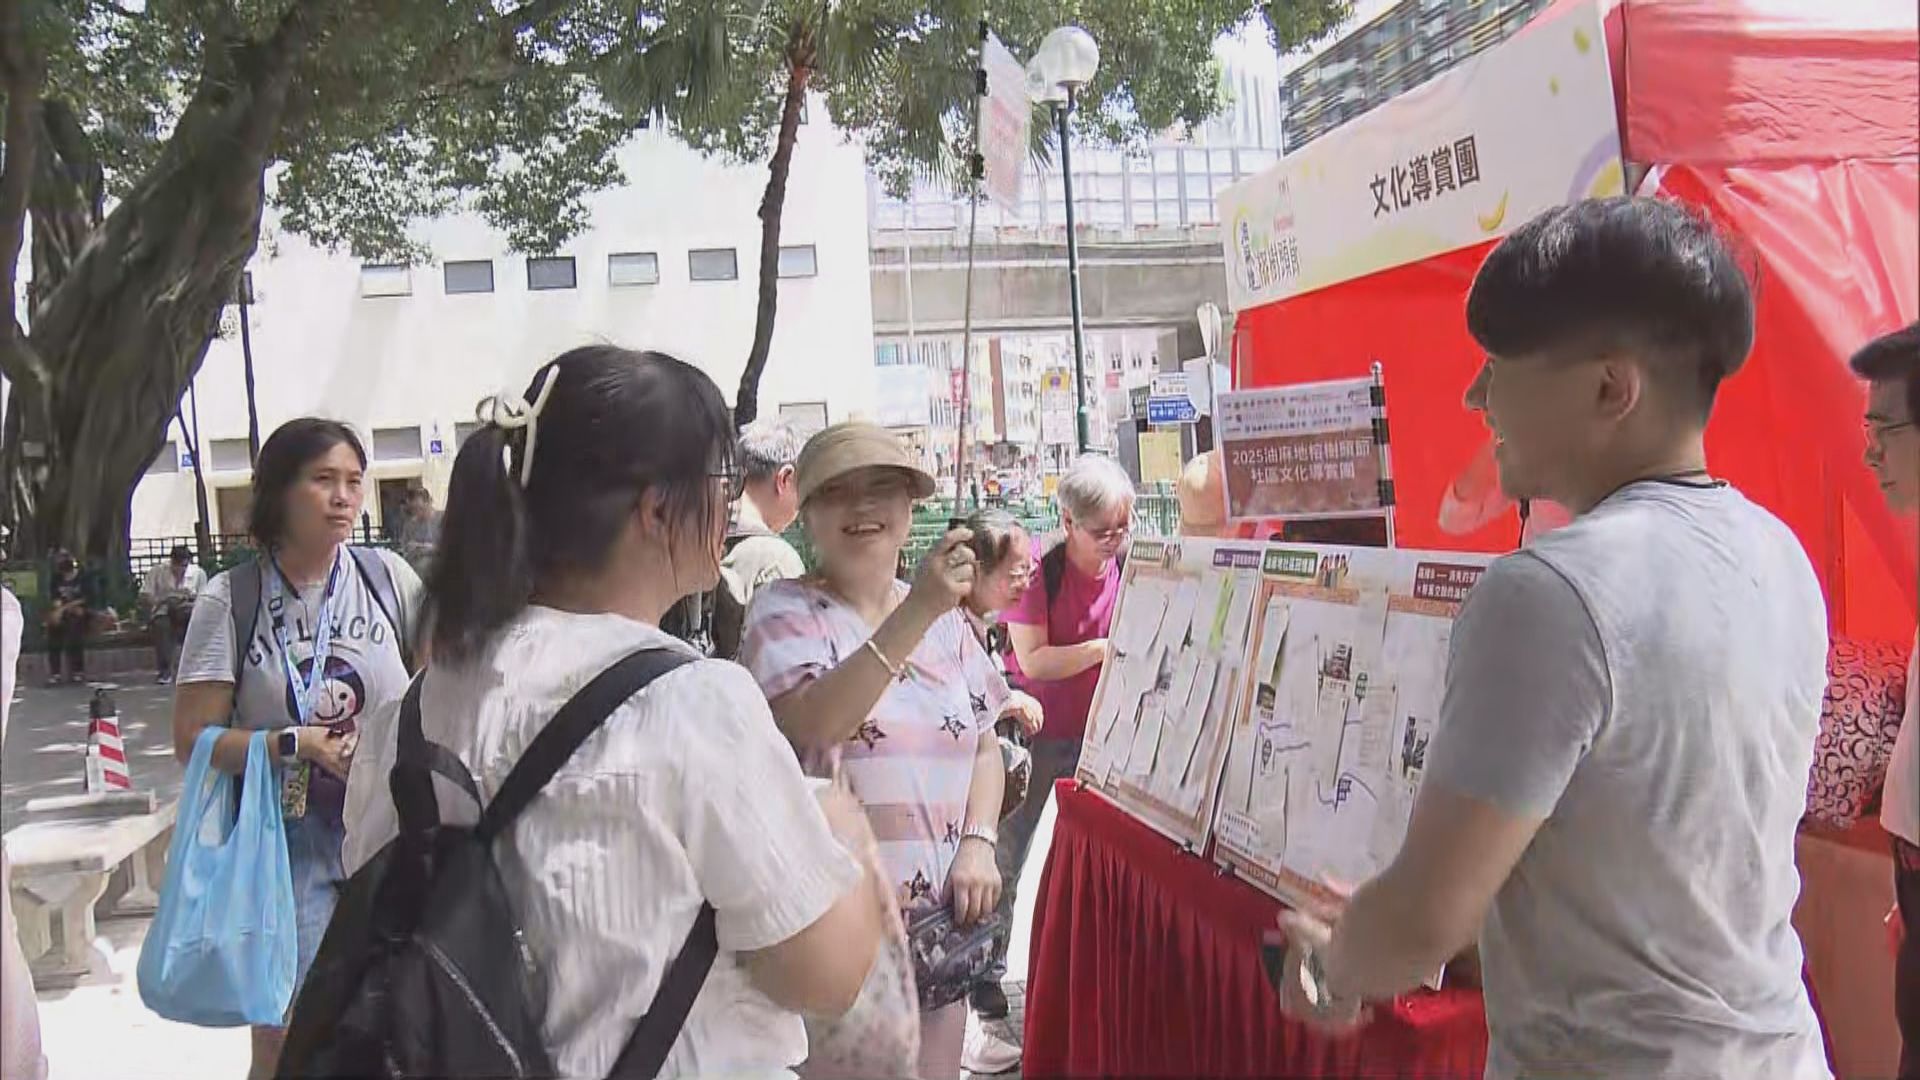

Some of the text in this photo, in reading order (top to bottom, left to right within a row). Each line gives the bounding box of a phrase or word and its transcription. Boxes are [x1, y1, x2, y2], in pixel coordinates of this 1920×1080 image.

[1370, 134, 1481, 217] 文化導賞團
[1251, 461, 1355, 484] 社區文化導賞團
